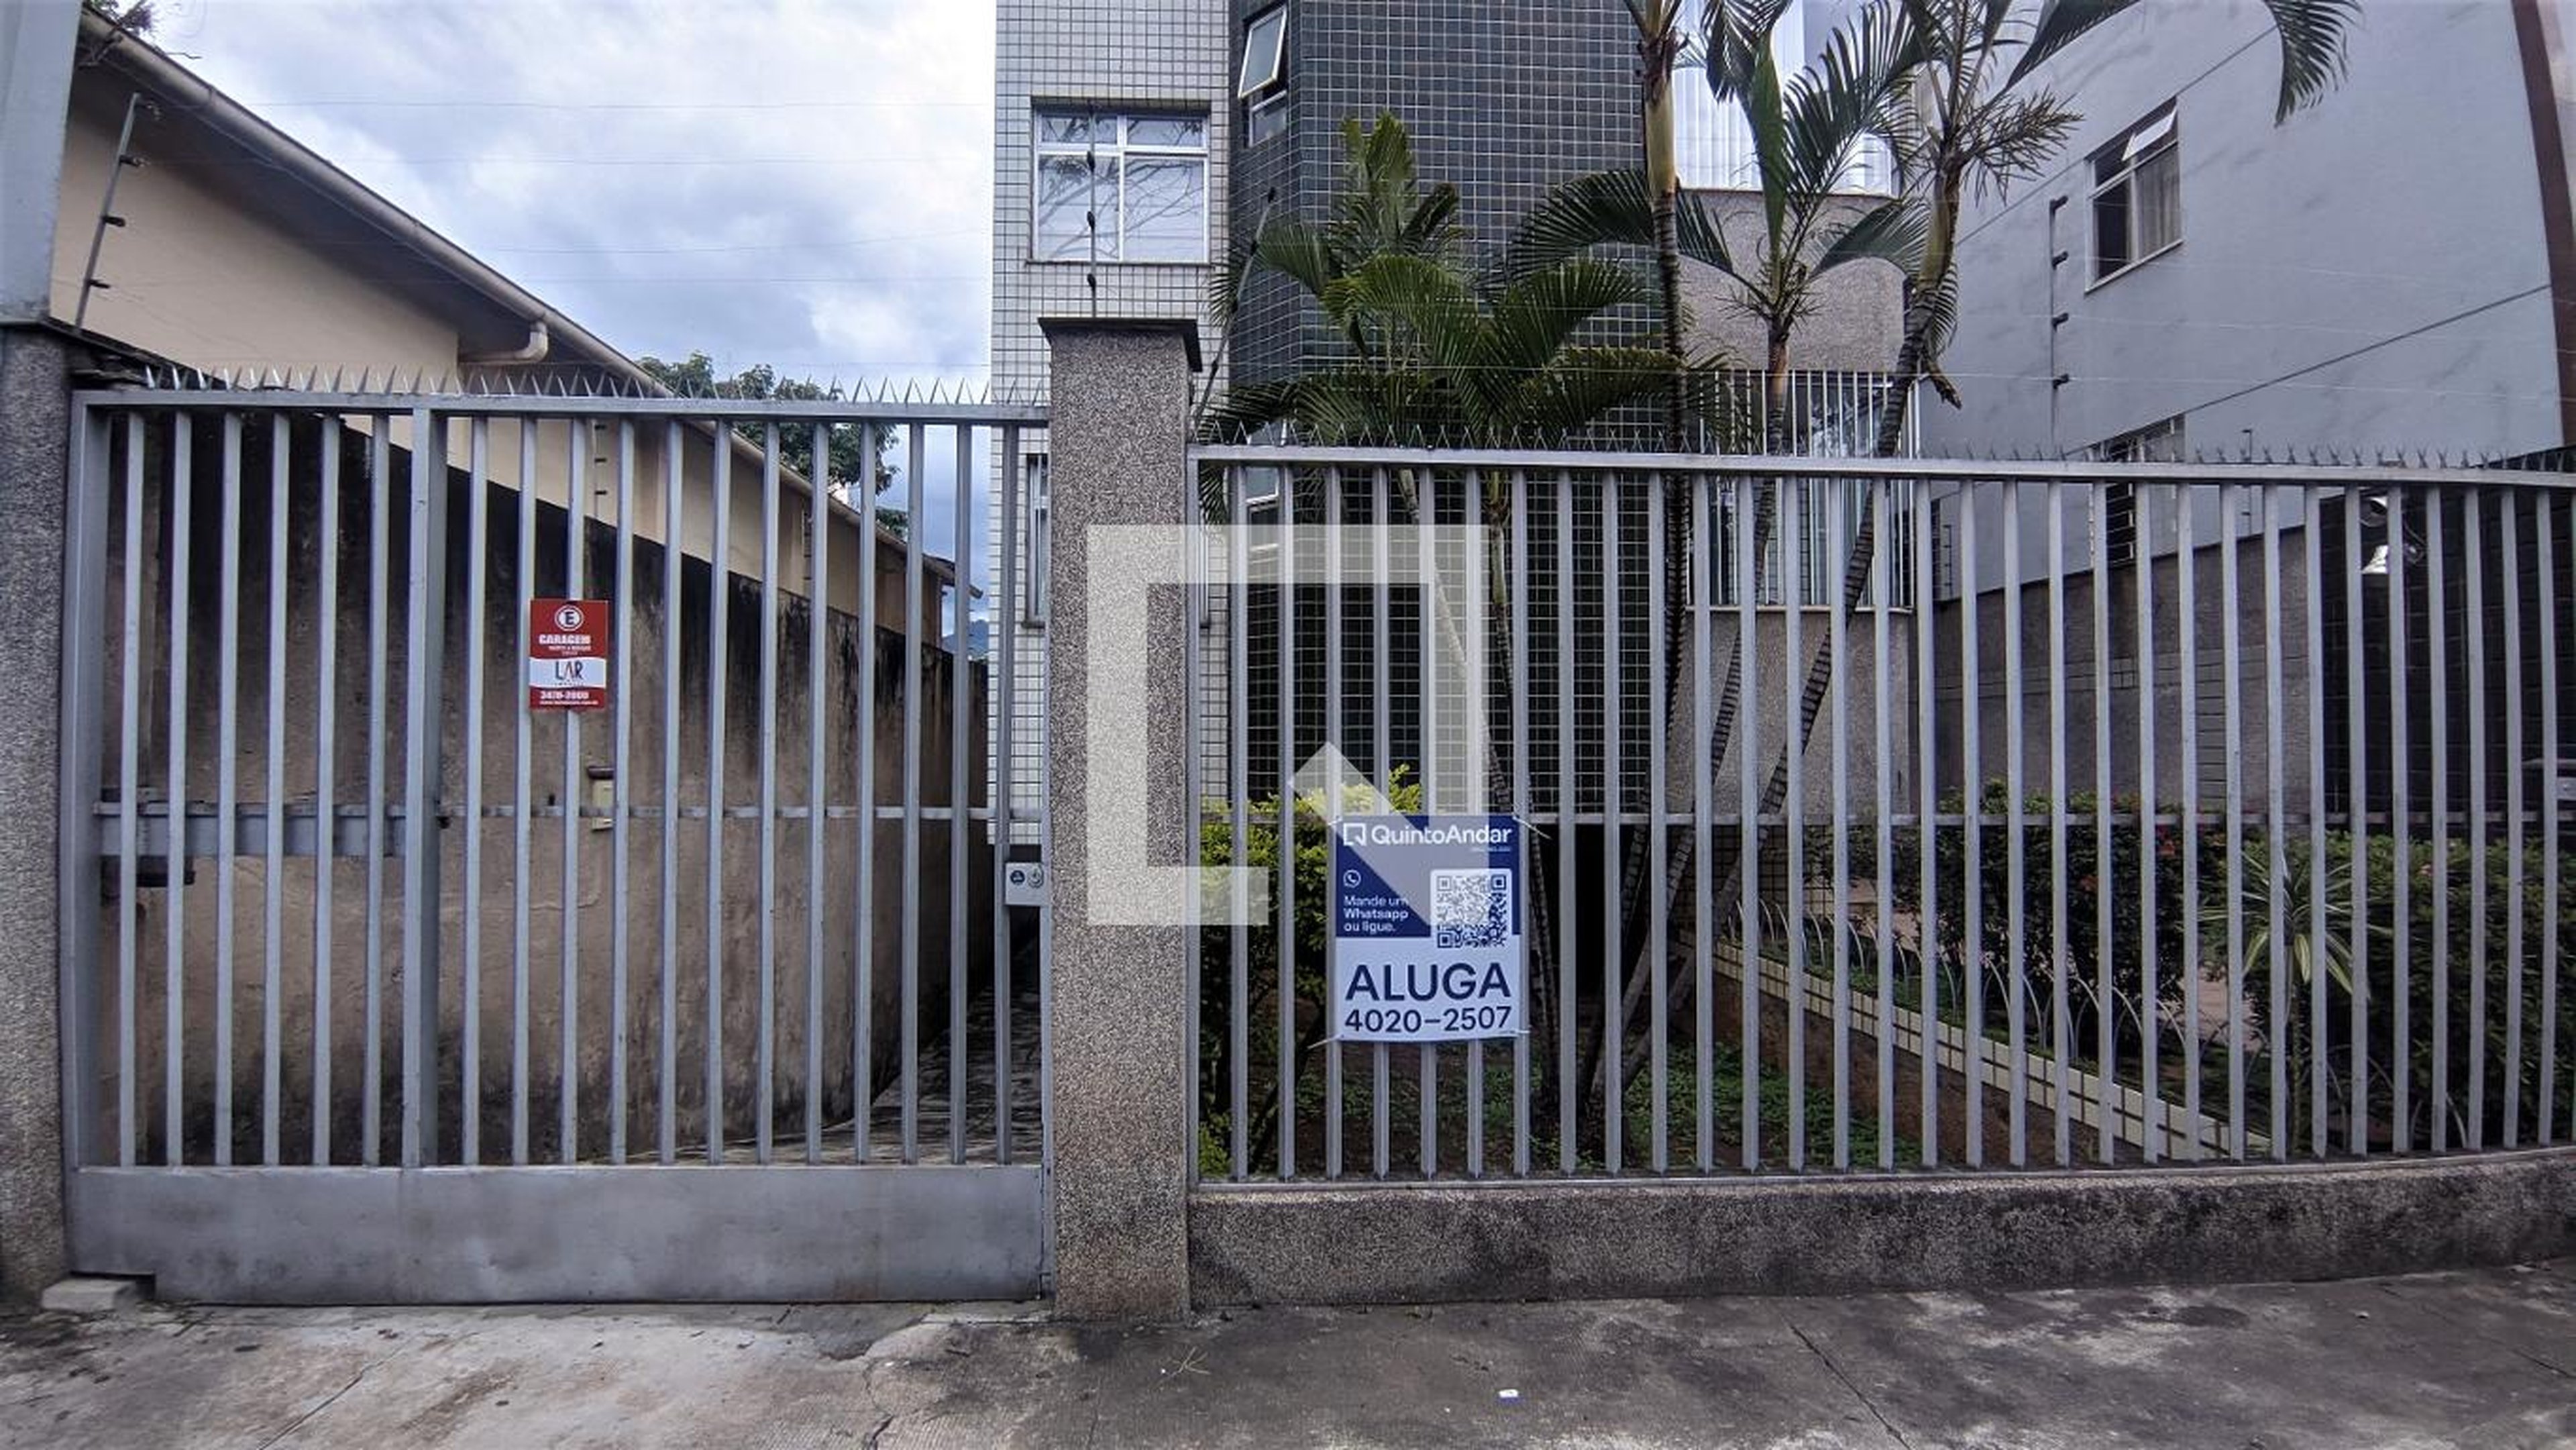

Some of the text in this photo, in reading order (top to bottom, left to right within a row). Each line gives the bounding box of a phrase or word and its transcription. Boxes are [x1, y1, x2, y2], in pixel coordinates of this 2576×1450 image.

[555, 660, 584, 680] LAR
[1371, 825, 1512, 845] QuintoAndar
[1344, 895, 1409, 906] Mande um
[1344, 908, 1409, 921] Whatsapp
[1344, 920, 1396, 935] ou ligue.
[1345, 962, 1512, 1001] ALUGA
[1344, 1006, 1512, 1033] 4020-2507
